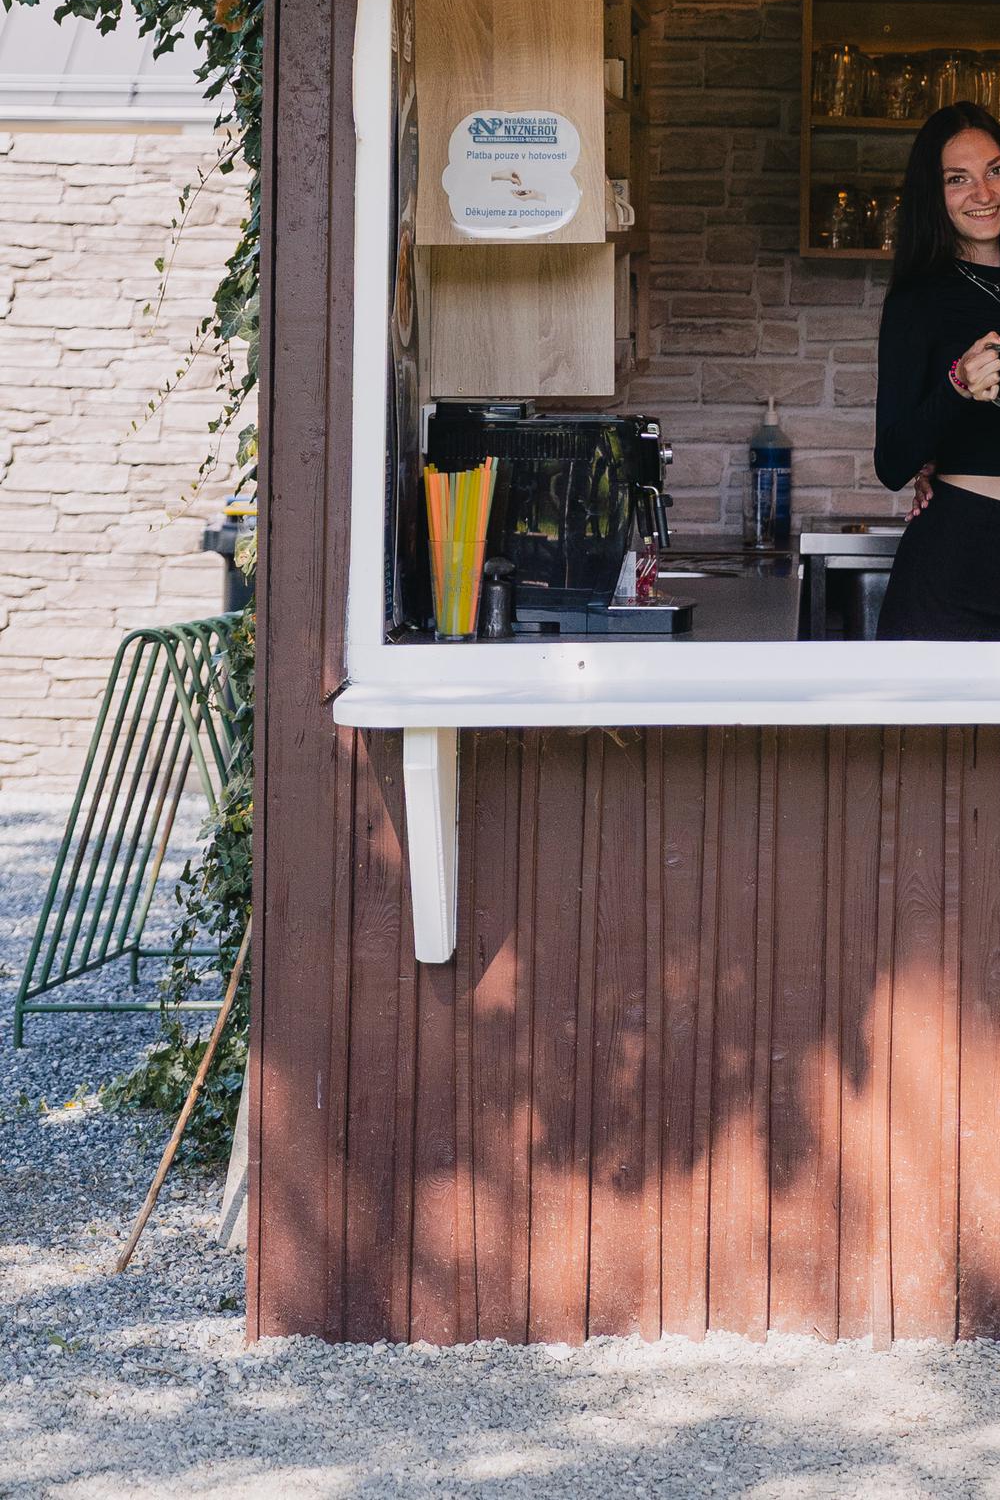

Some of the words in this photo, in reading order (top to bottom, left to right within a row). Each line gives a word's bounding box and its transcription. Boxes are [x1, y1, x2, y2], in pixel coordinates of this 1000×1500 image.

[466, 151, 492, 159] Platba
[494, 153, 519, 161] pouze
[528, 151, 567, 159] hotovosti
[465, 207, 506, 218] Děkujeme
